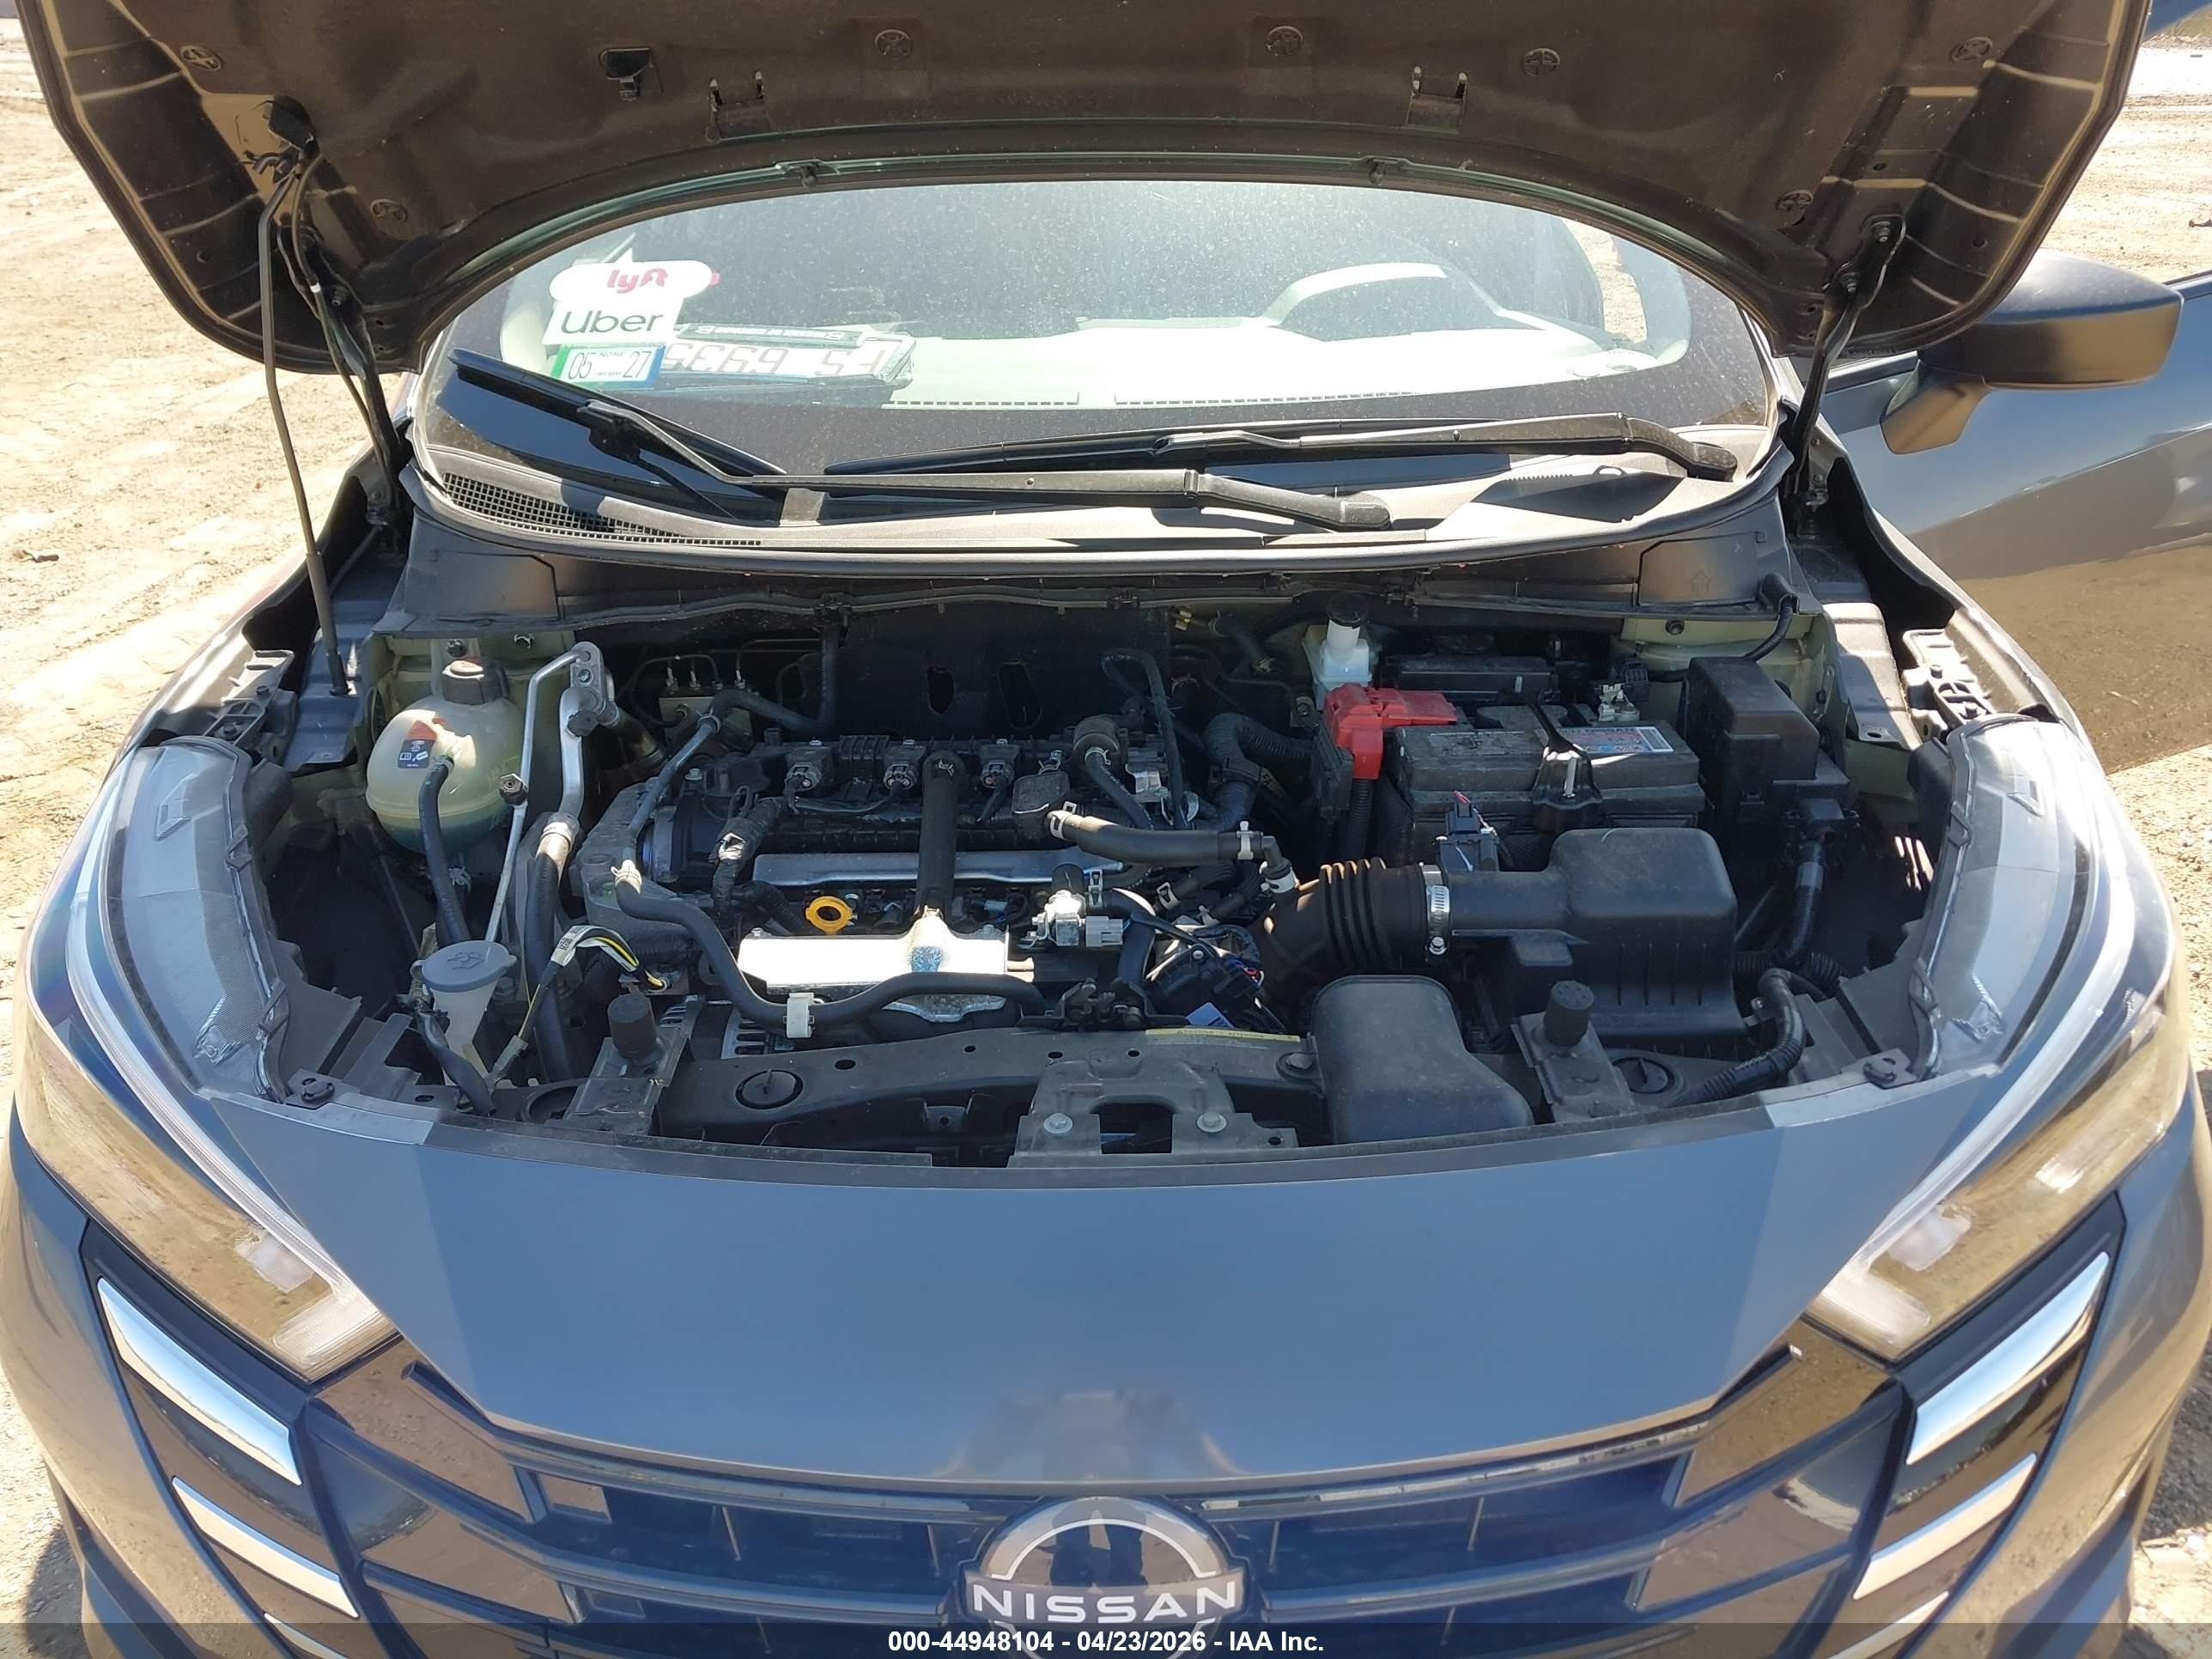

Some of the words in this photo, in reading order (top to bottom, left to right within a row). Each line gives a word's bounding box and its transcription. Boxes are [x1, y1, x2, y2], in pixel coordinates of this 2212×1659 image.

[607, 268, 668, 294] lyft
[561, 310, 665, 334] Uber
[568, 352, 597, 380] 05
[623, 350, 652, 378] 27
[972, 1580, 1237, 1623] NISSAN
